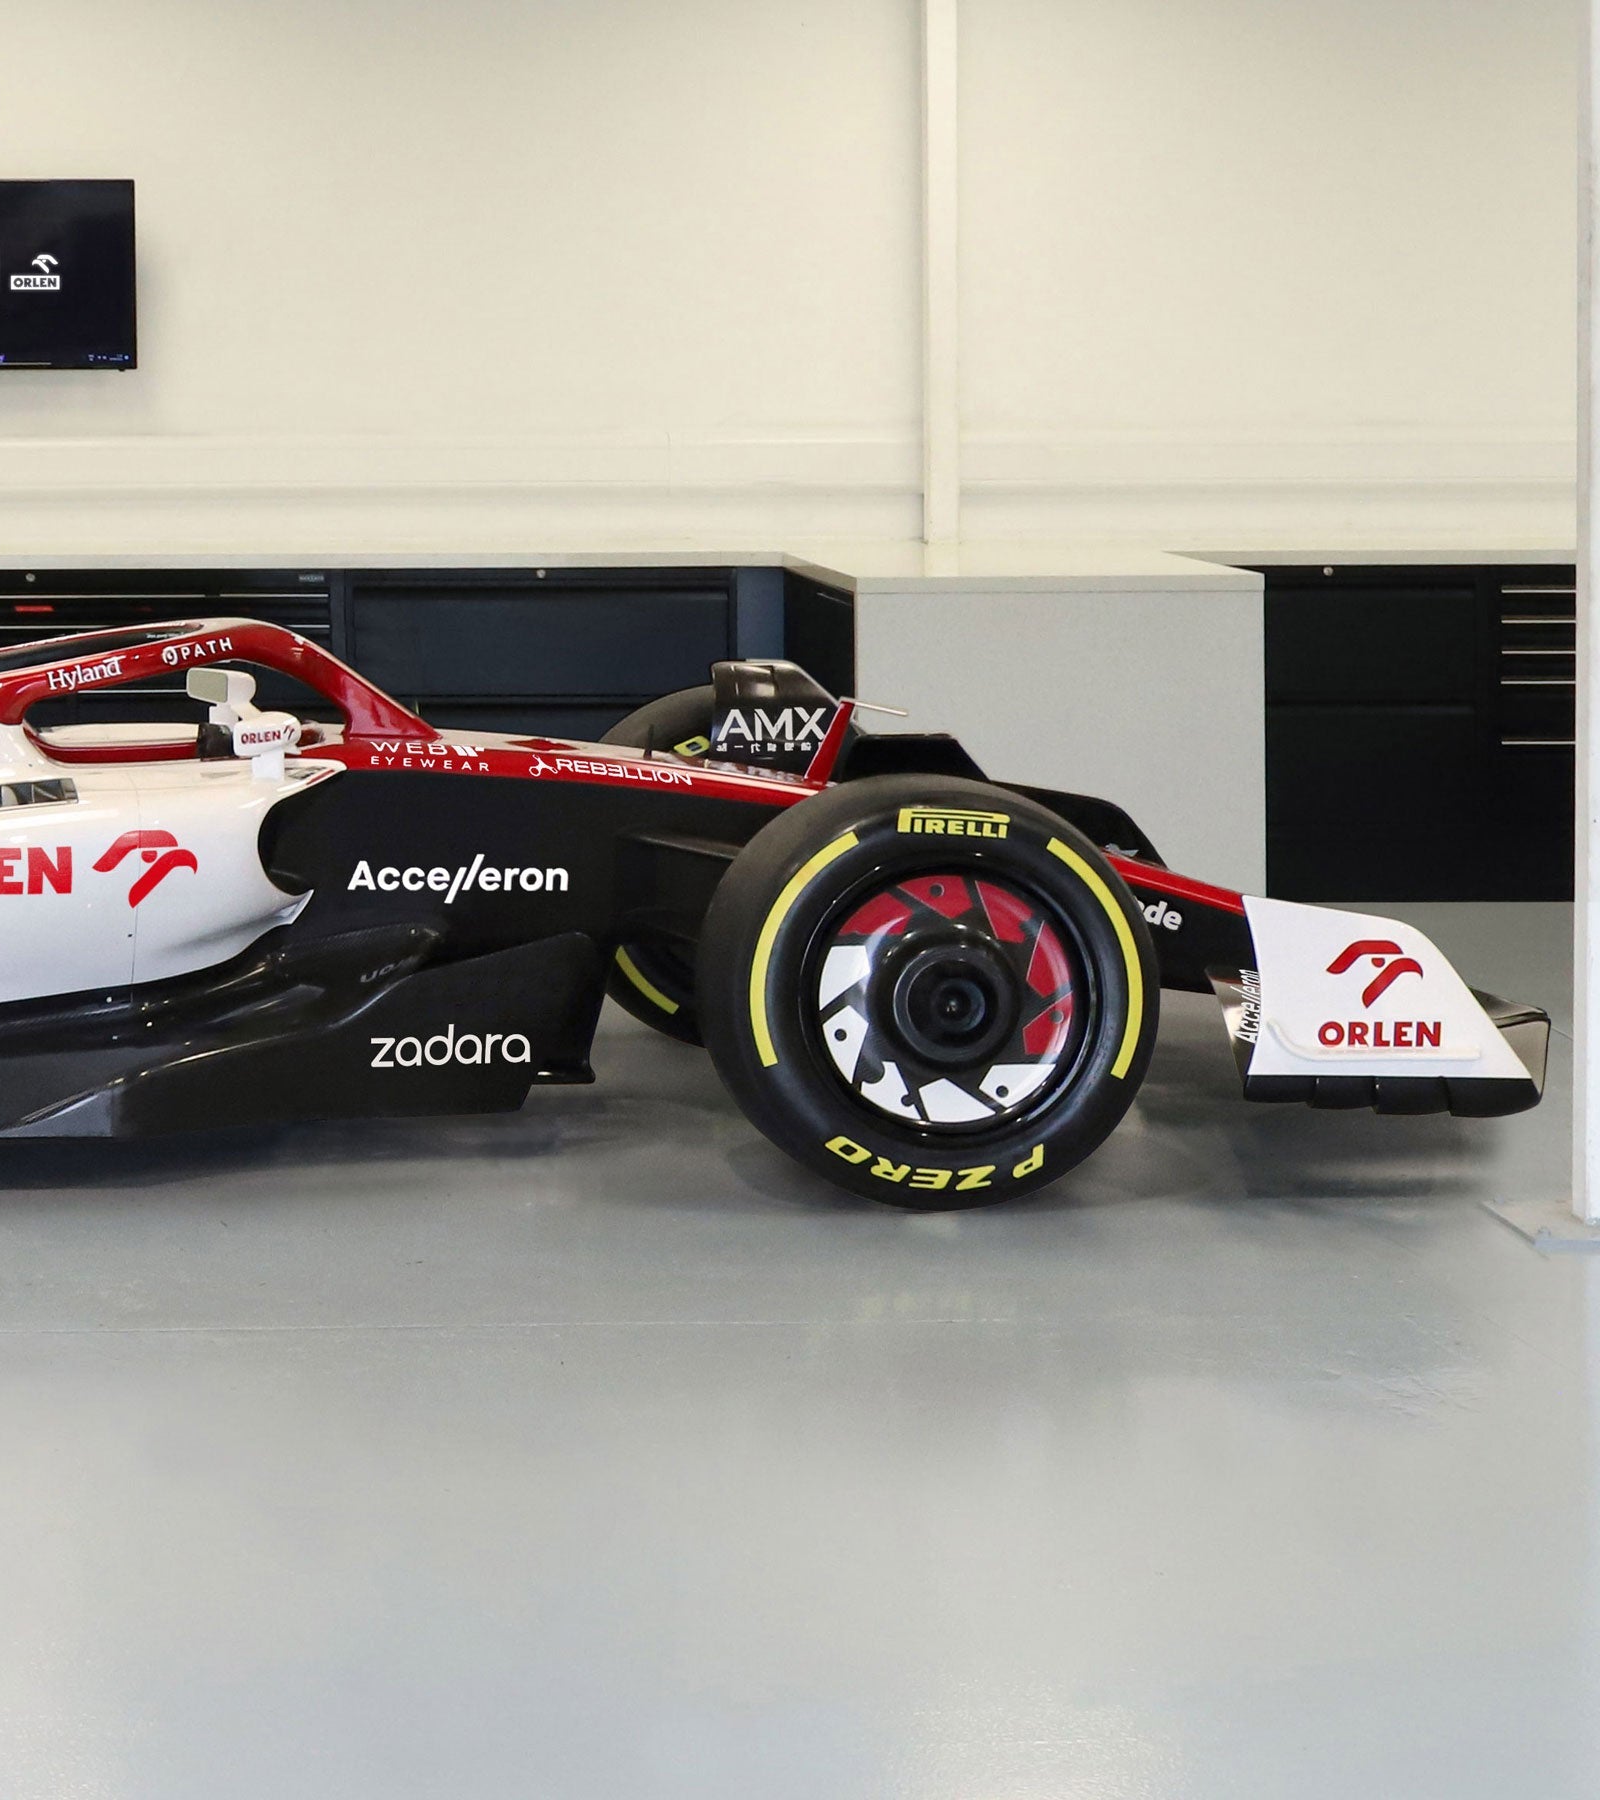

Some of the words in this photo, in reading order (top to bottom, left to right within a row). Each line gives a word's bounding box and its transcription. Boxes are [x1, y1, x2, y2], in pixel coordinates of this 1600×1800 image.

[13, 277, 58, 288] ORLEN
[47, 657, 122, 691] Hyland
[241, 730, 282, 744] ORLEN
[717, 707, 827, 741] AMX
[370, 741, 447, 756] WEB
[370, 756, 489, 772] EYEWEAR
[897, 808, 1011, 839] PIRELLI
[370, 1023, 531, 1068] zadara
[1318, 1021, 1442, 1047] ORLEN
[824, 1135, 997, 1191] ZERO
[1012, 1143, 1045, 1180] P
